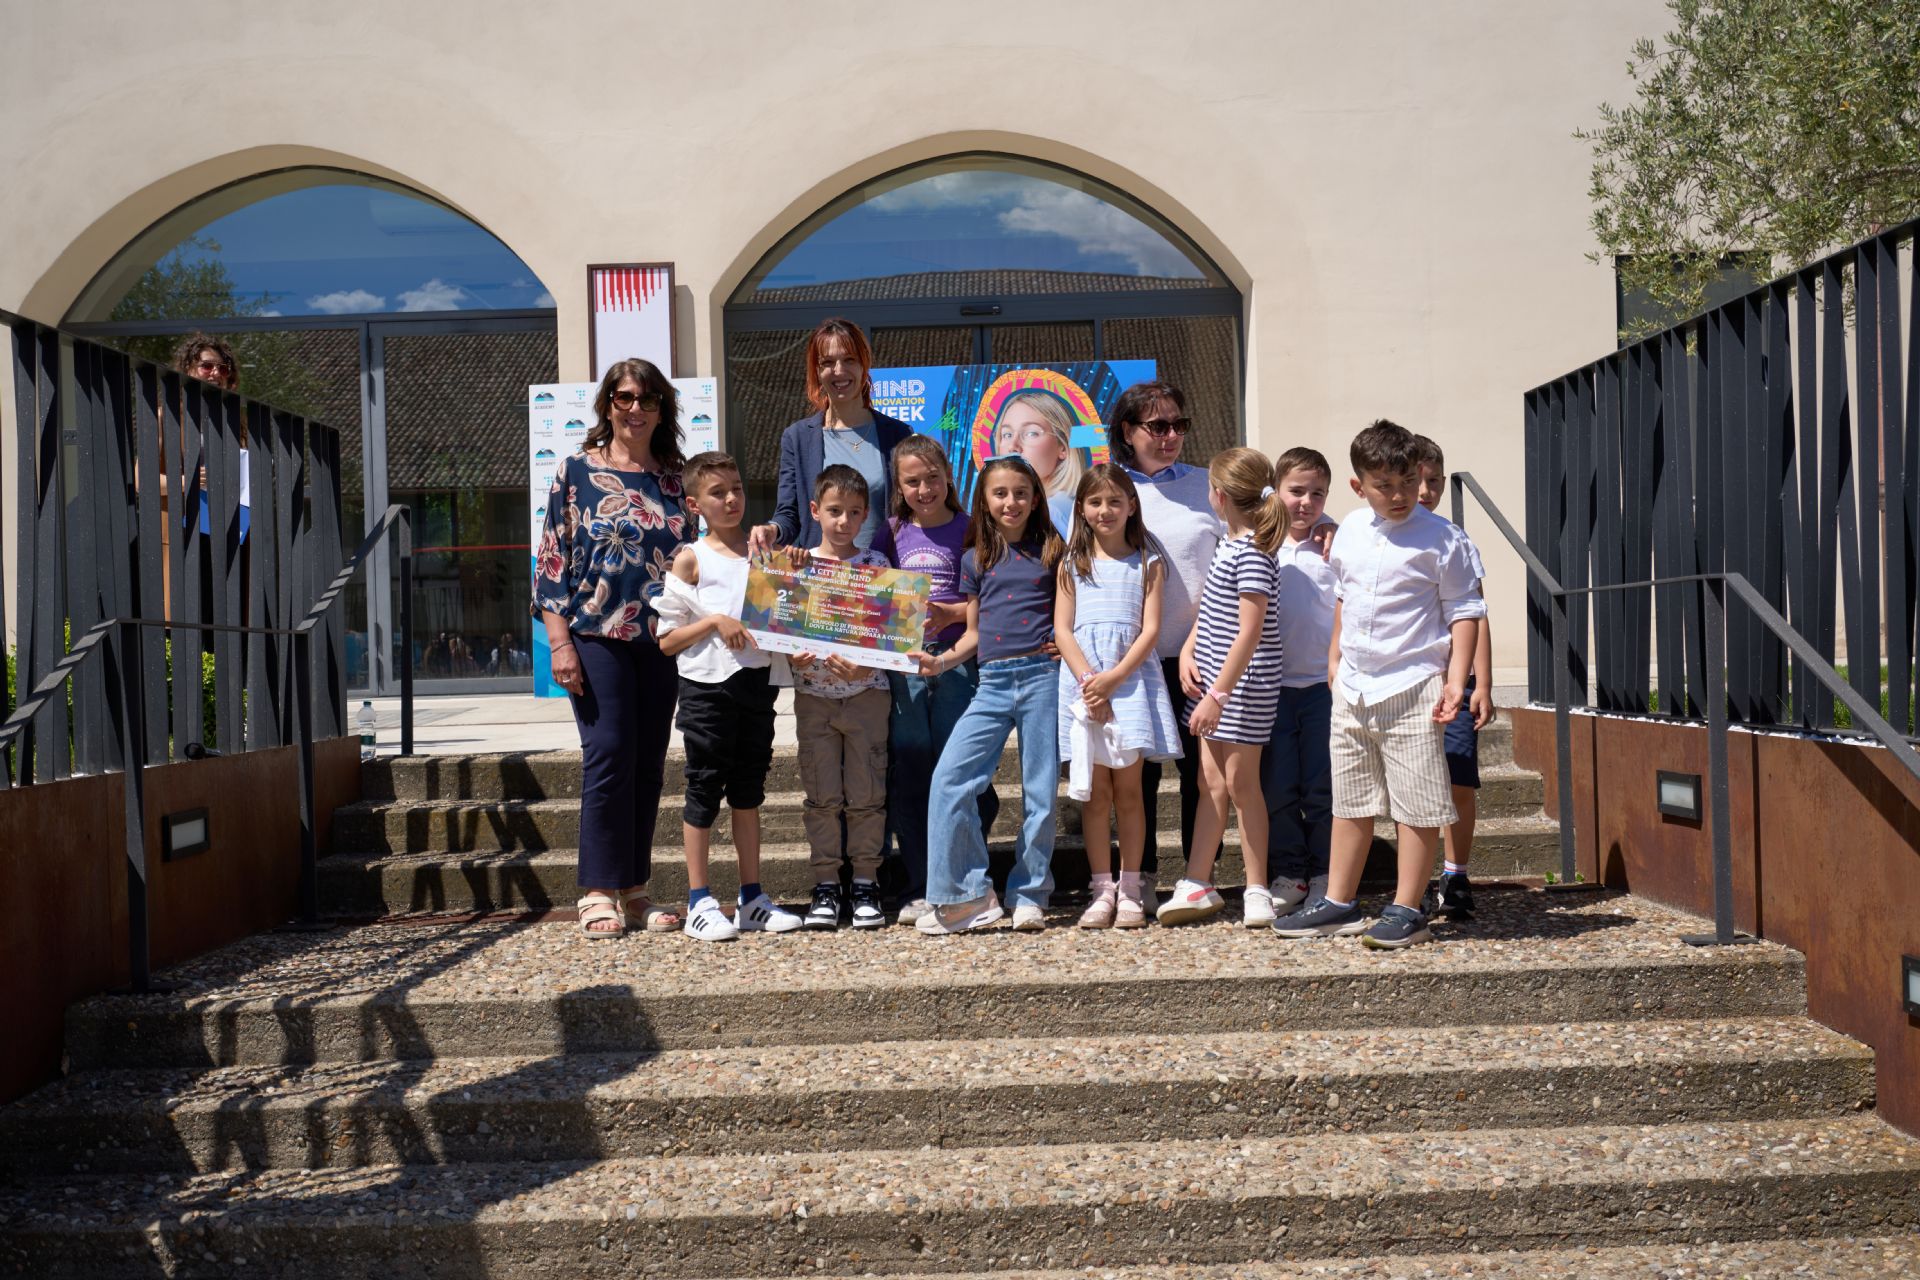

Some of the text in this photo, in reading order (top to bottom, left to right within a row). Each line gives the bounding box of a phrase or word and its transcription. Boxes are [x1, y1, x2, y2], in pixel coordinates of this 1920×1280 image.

[872, 397, 926, 406] NOVATION
[763, 568, 785, 576] Faccio
[808, 576, 848, 585] economiche
